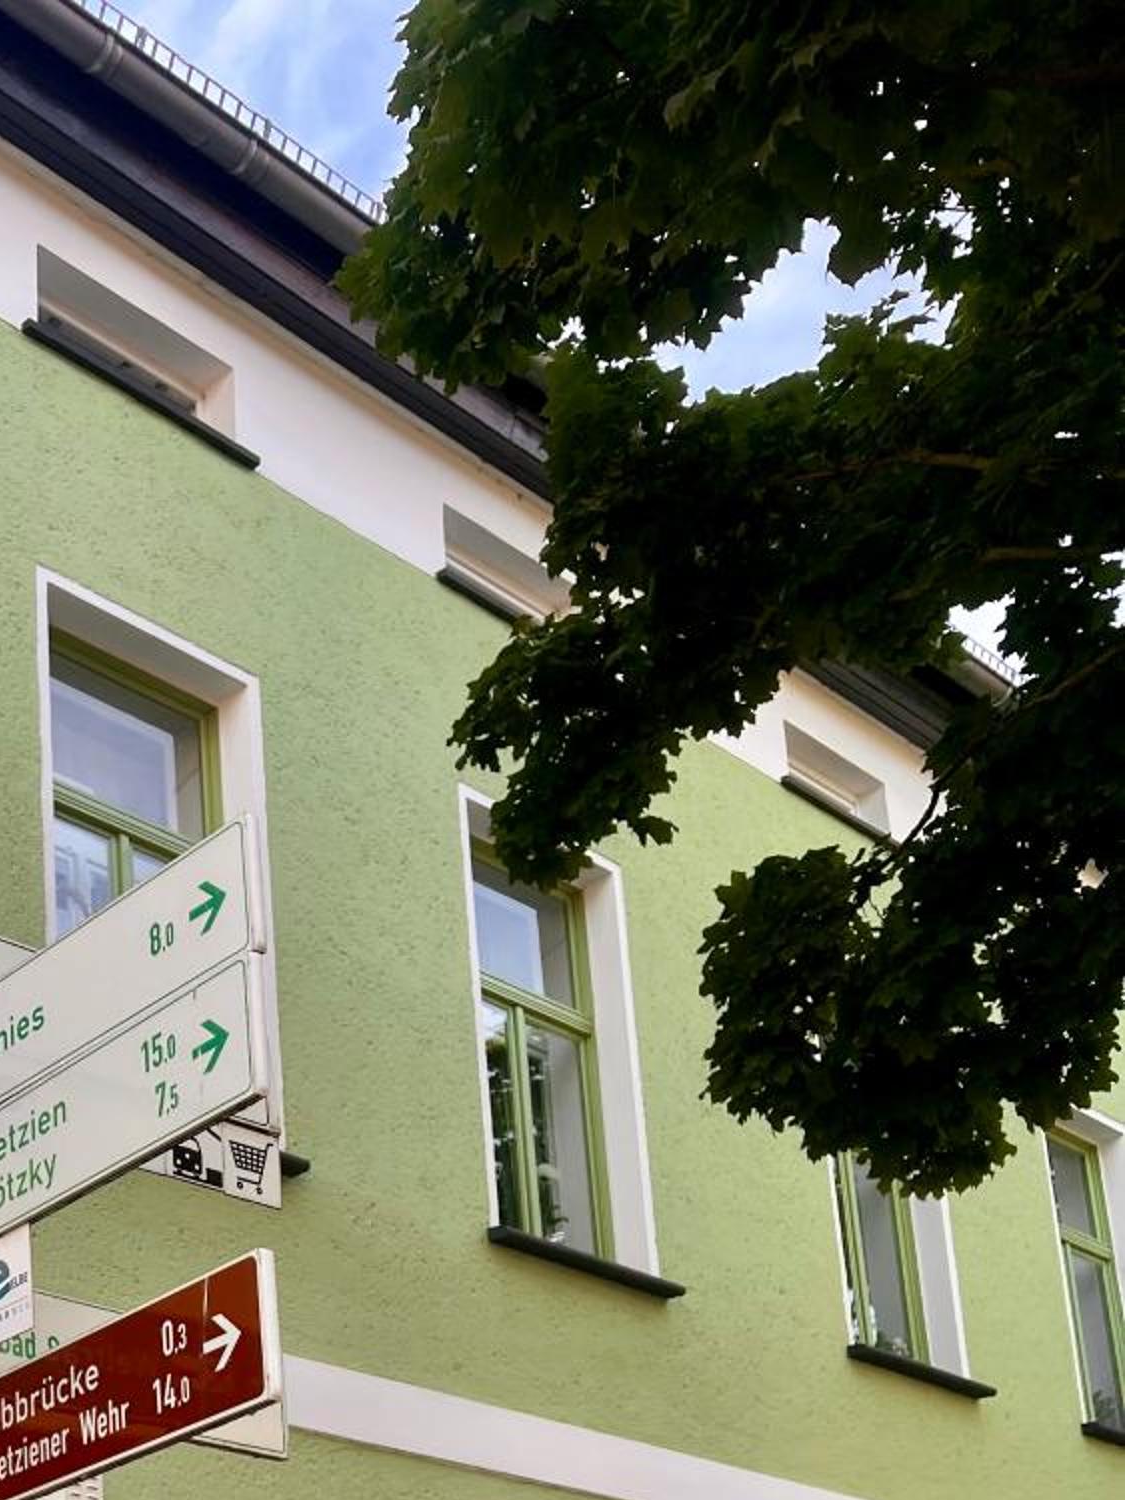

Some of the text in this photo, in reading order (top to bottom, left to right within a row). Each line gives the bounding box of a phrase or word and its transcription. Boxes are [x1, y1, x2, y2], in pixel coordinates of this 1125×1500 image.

[148, 921, 174, 957] 8.0
[140, 1031, 176, 1073] 15.0
[160, 1319, 188, 1357] 0.3
[78, 1399, 130, 1446] Wehr
[152, 1373, 190, 1414] 14.0
